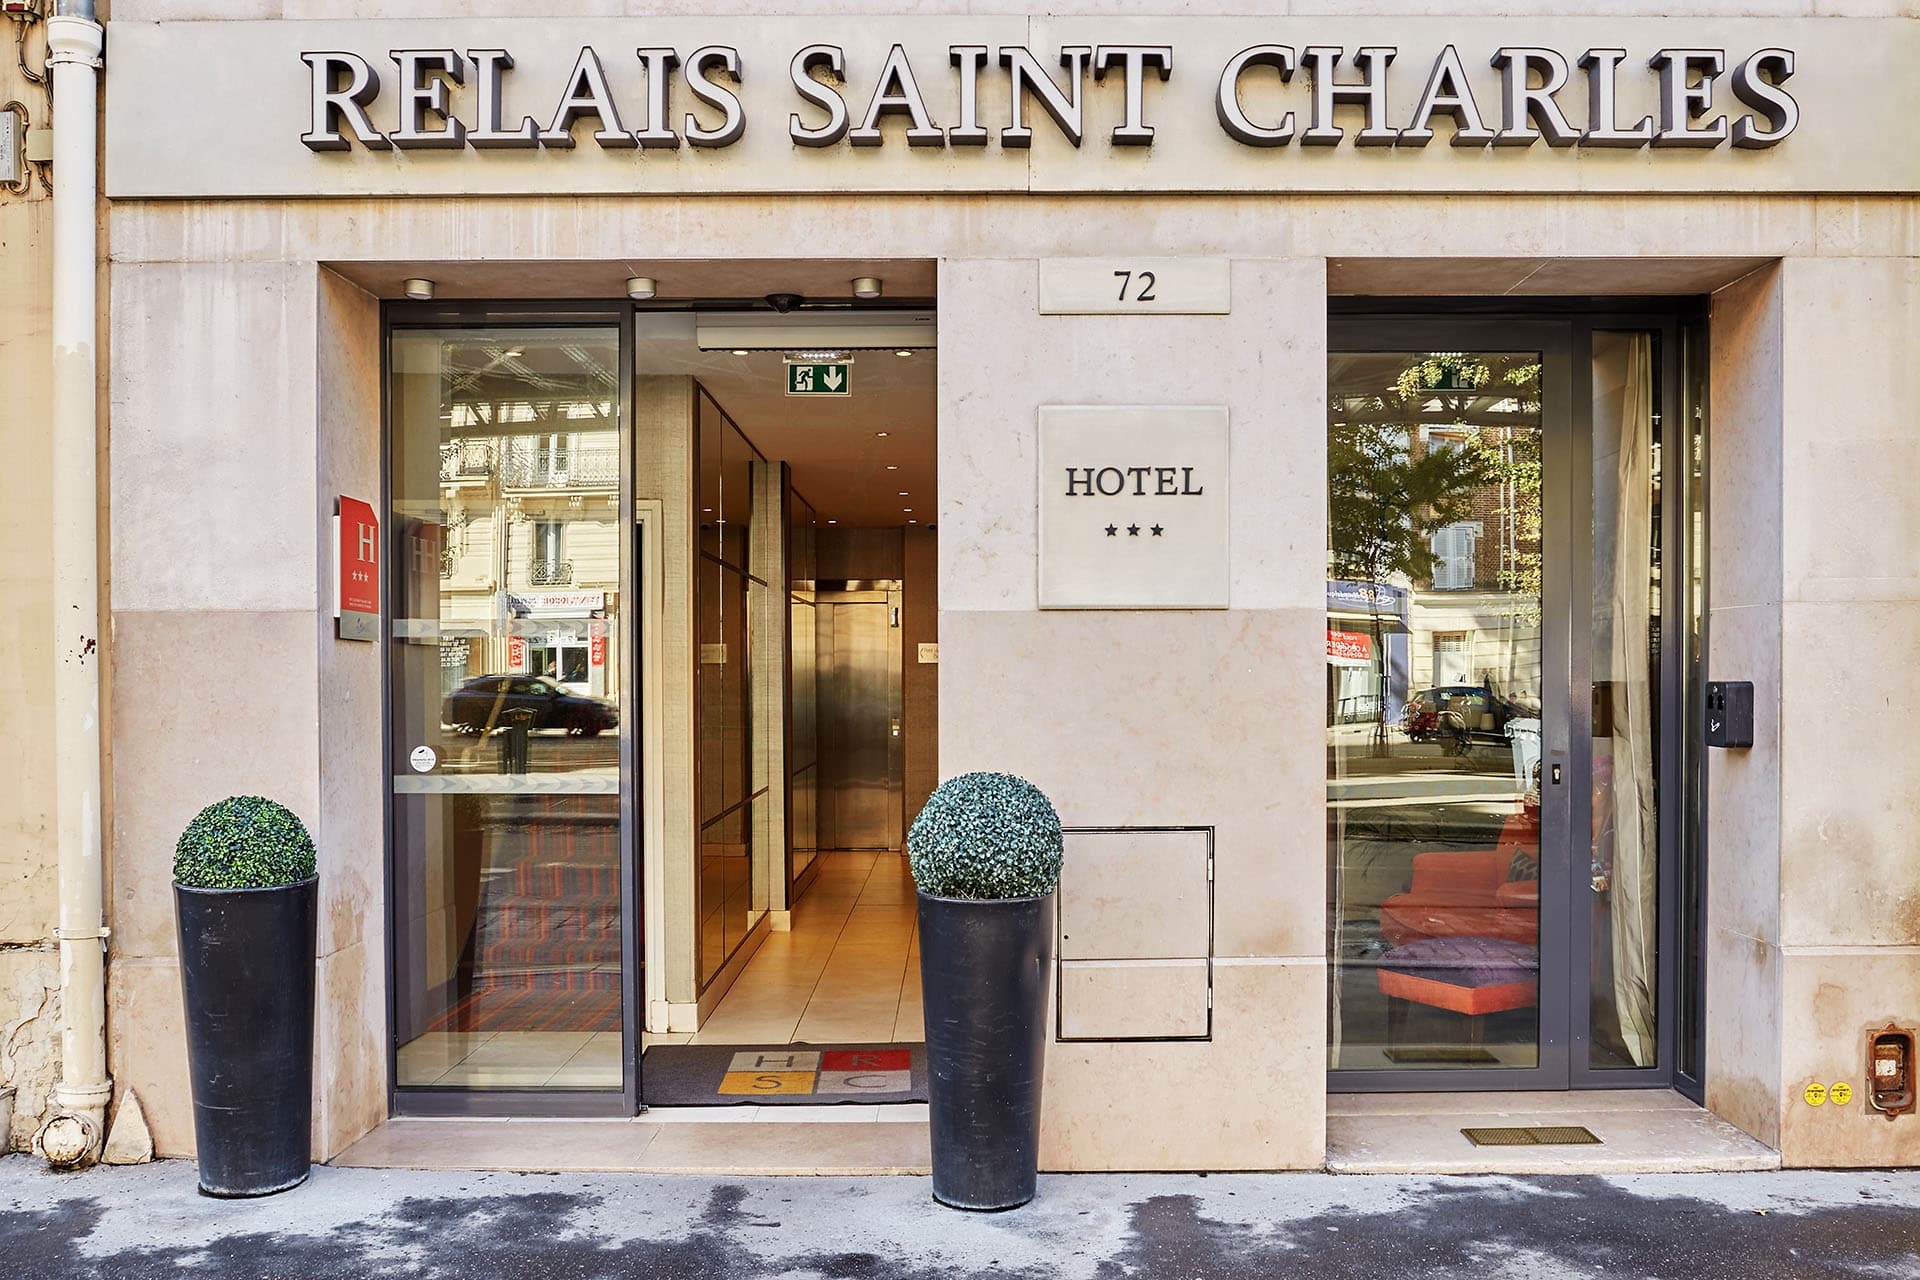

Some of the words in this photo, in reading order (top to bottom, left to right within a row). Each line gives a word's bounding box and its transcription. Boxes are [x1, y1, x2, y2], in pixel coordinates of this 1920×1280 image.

[300, 46, 745, 151] RELAIS
[789, 43, 1173, 147] SAINT
[1216, 44, 1800, 149] CHARLES
[1114, 270, 1156, 301] 72
[1065, 467, 1204, 496] HOTEL
[358, 522, 375, 563] H
[755, 1055, 795, 1067] H
[851, 1055, 880, 1067] R
[752, 1075, 782, 1089] S
[842, 1074, 887, 1088] C
